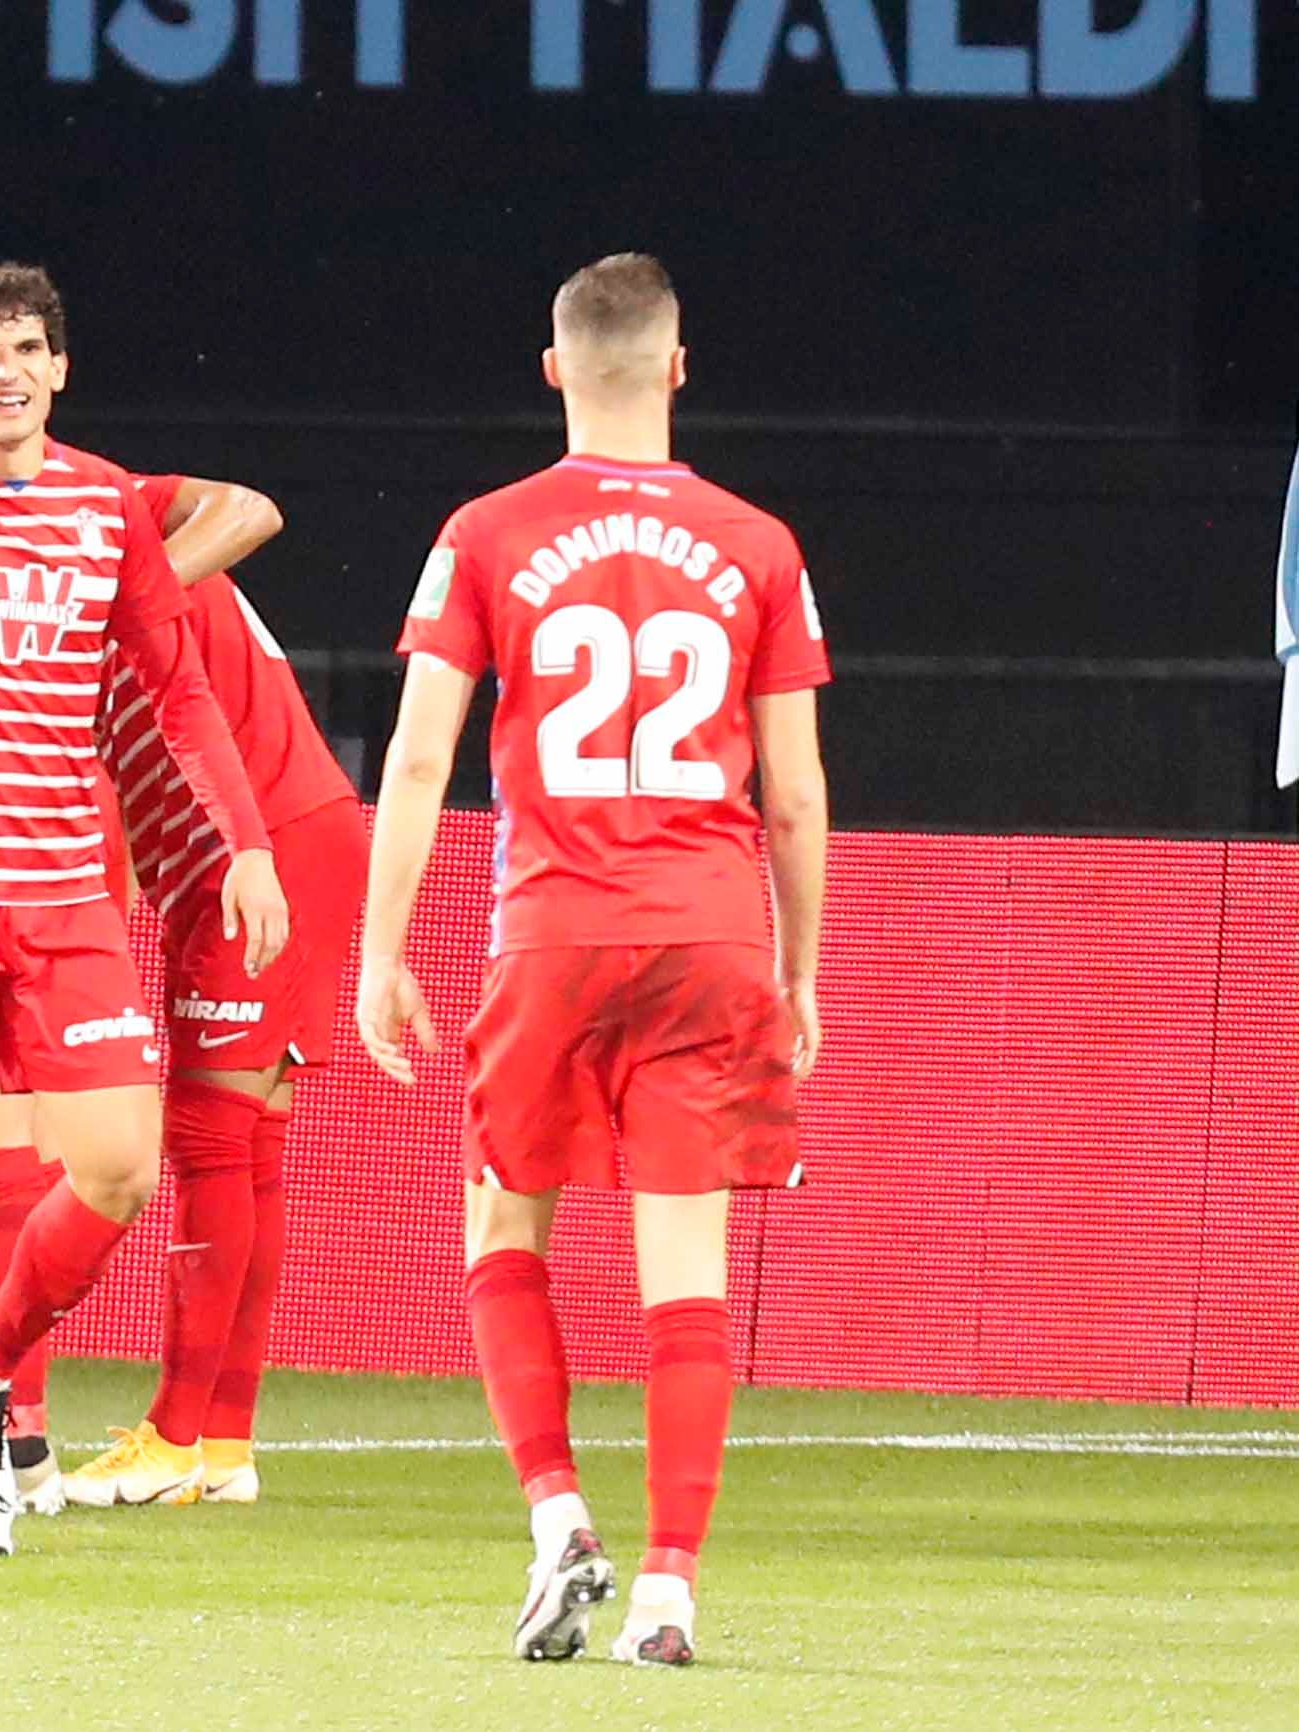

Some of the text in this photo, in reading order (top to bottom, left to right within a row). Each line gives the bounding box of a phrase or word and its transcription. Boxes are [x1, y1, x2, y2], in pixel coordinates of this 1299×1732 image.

[509, 512, 746, 618] DOMINGOS D.
[531, 604, 731, 800] 22
